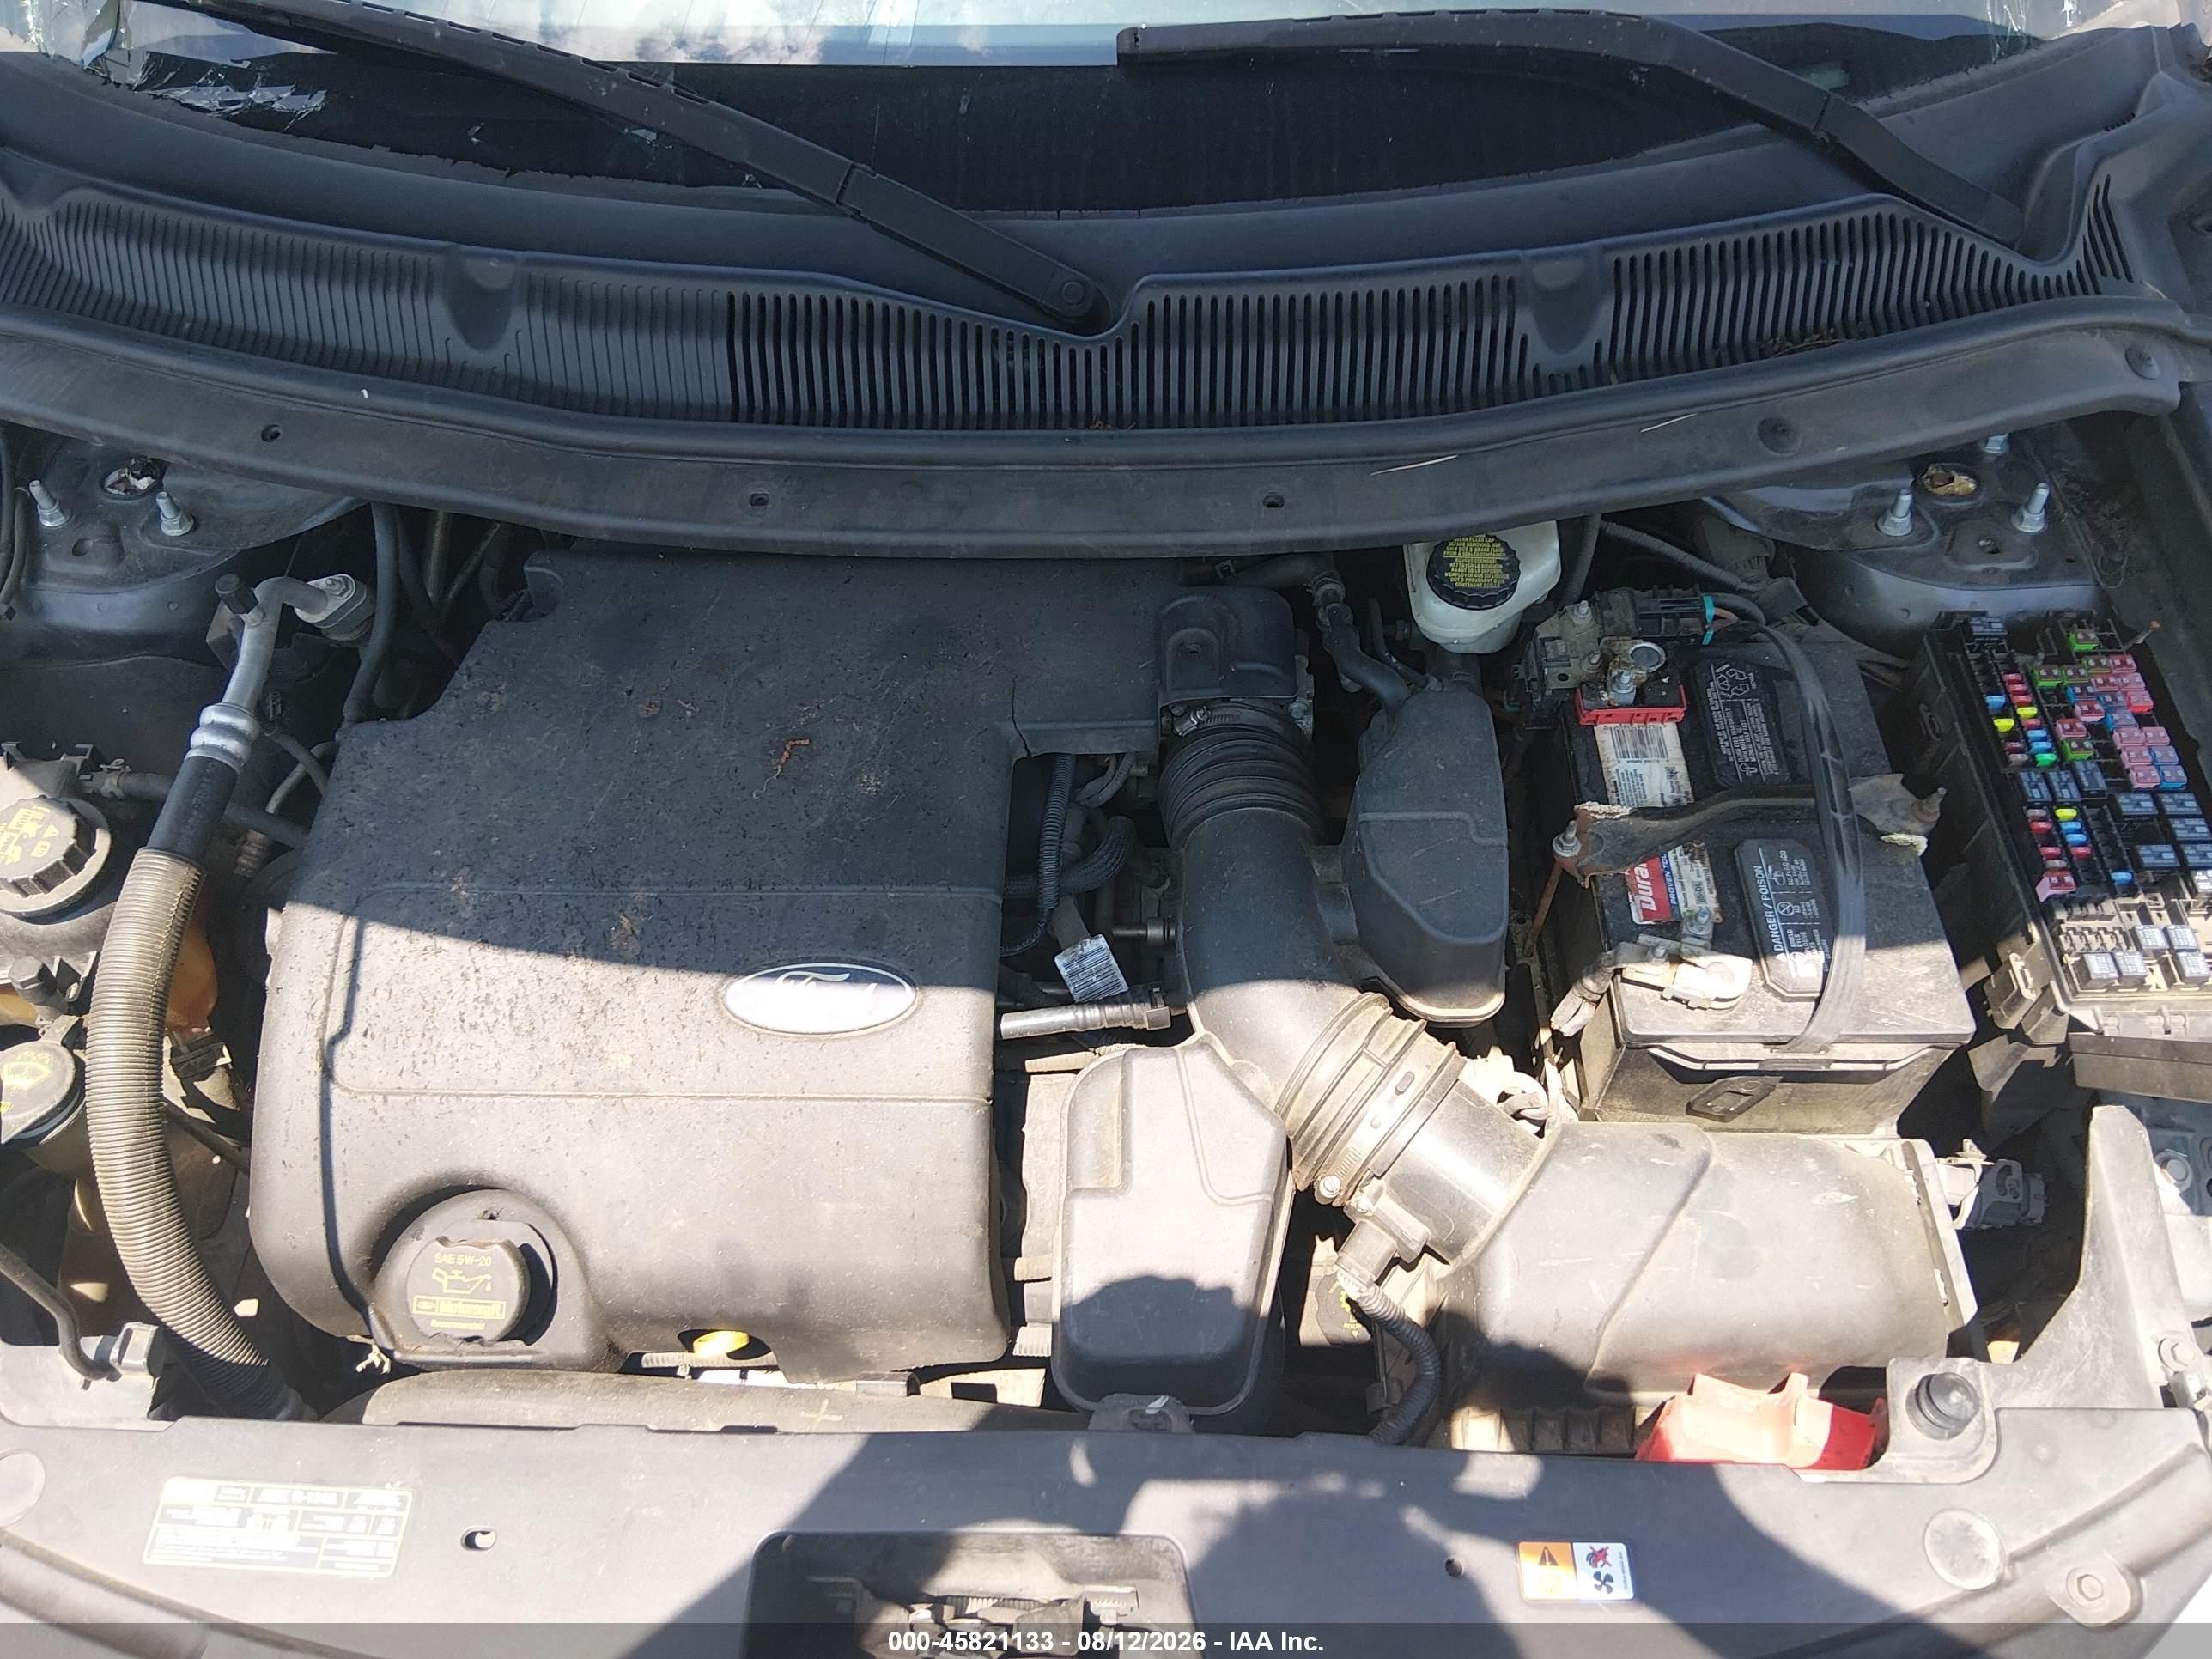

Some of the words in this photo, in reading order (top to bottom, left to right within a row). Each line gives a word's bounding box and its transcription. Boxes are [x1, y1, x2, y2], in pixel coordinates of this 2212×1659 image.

[1664, 871, 1677, 904] PROVEN
[1753, 866, 1771, 900] POISON
[1767, 911, 1784, 951] DANGER
[434, 1252, 455, 1264] SAE
[456, 1255, 492, 1267] 5W-20
